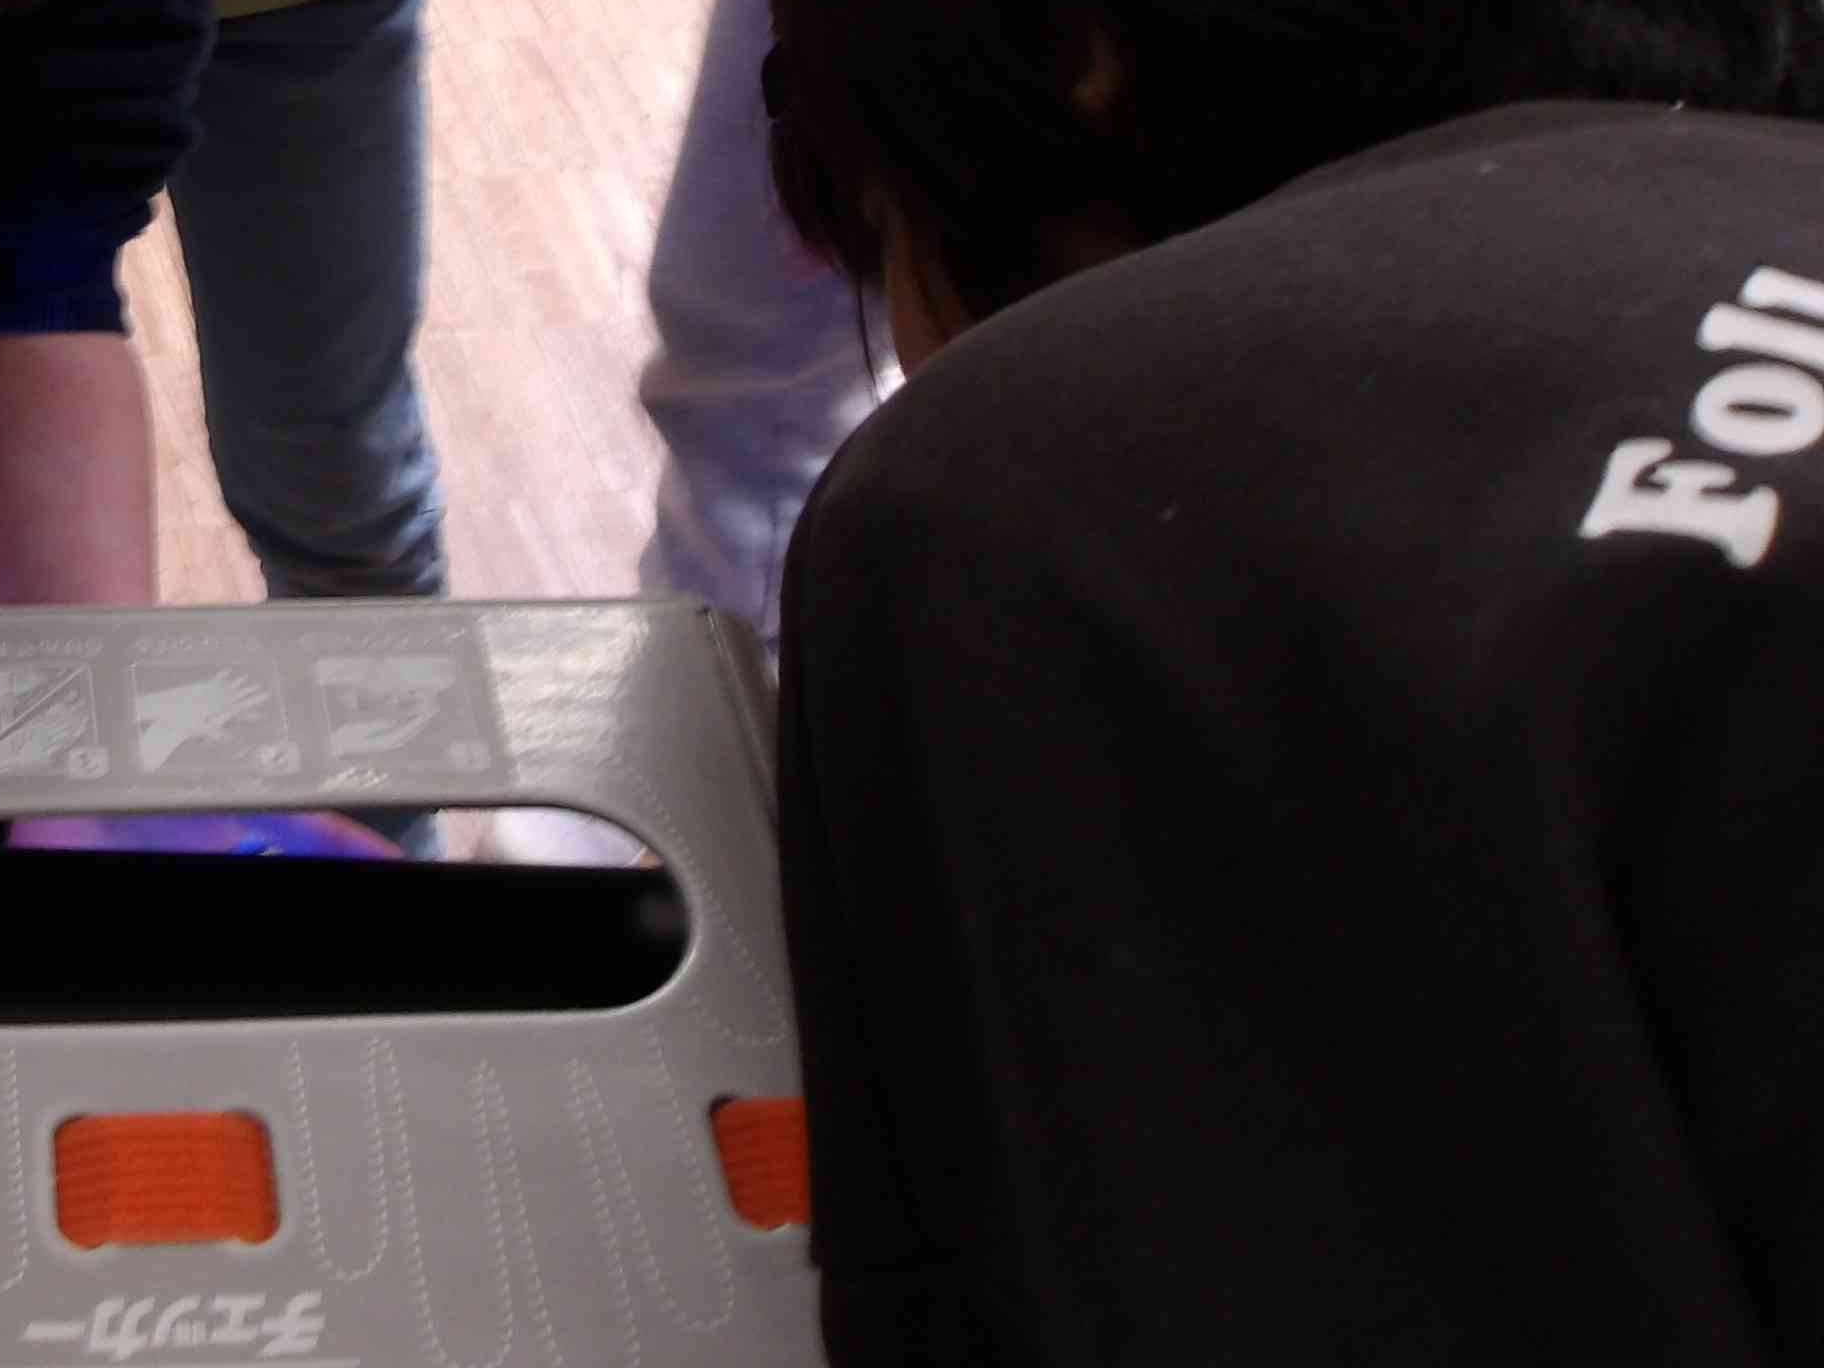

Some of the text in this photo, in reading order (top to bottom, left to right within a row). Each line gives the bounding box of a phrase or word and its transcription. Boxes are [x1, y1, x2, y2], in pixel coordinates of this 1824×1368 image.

[20, 1289, 326, 1362] チェッカー
